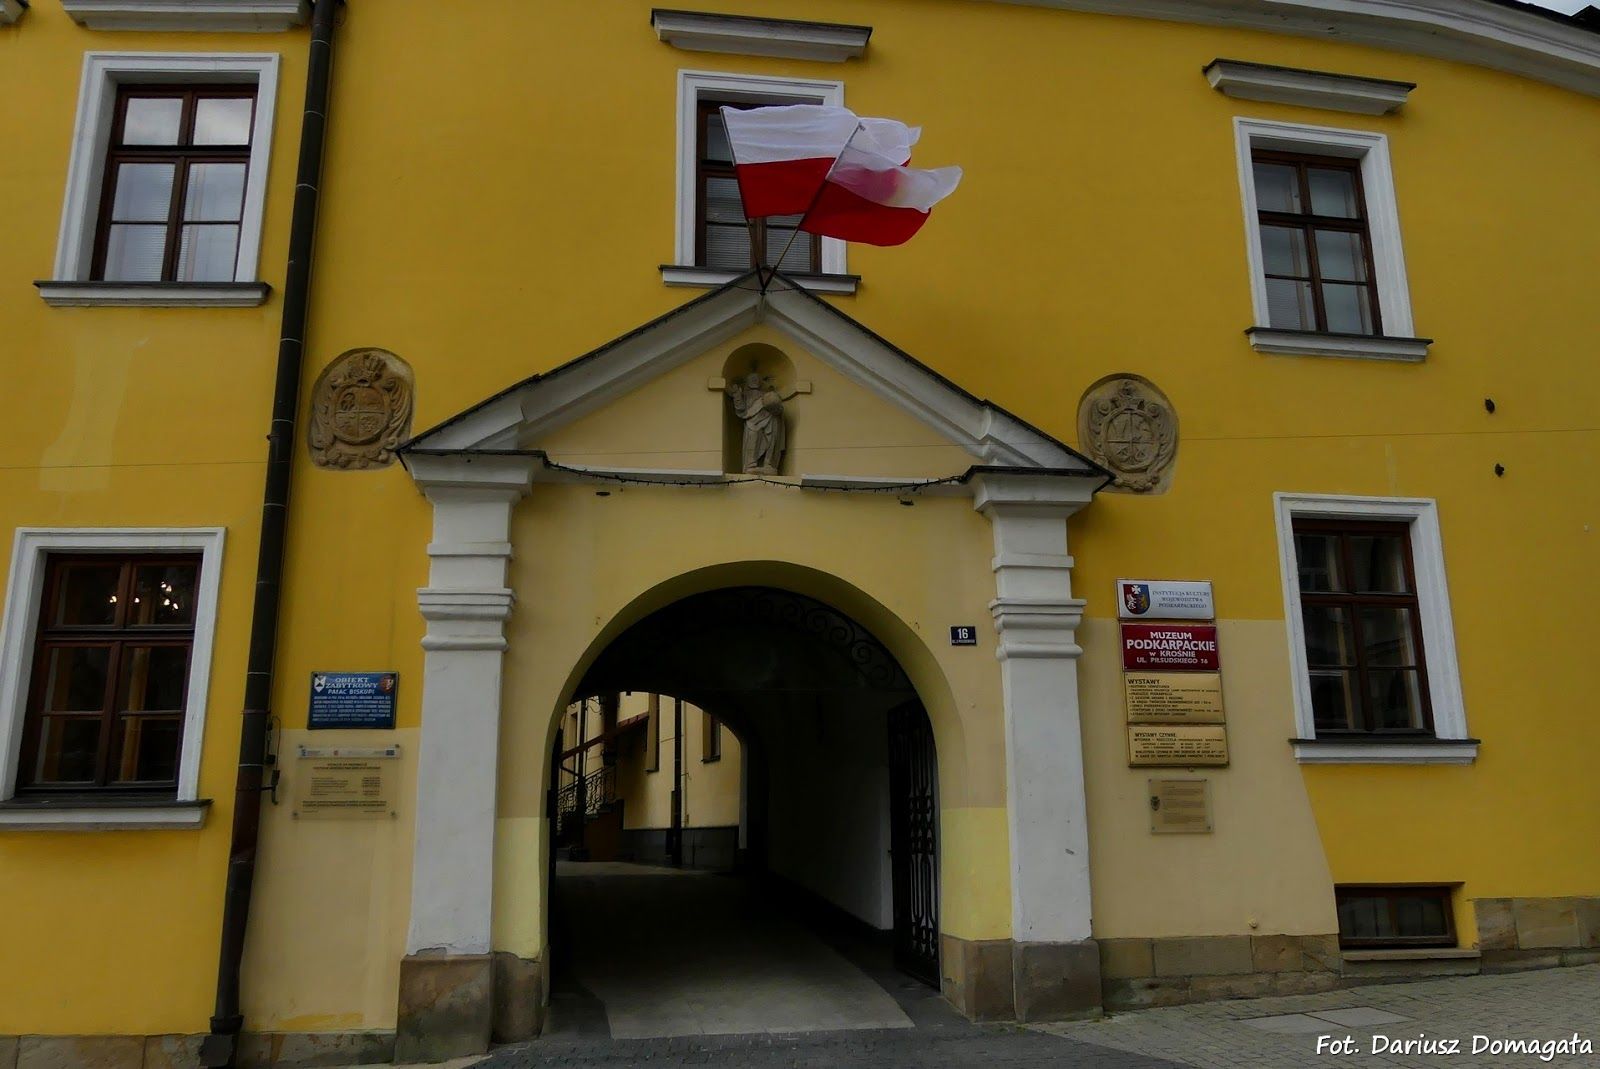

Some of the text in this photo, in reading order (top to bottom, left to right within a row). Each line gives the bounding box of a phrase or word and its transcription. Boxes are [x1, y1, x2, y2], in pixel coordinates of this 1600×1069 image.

[957, 628, 969, 639] 16
[1150, 631, 1192, 640] MUZEUM
[1126, 639, 1216, 652] PODKARPACKIE
[1160, 649, 1196, 658] KROŚNIE
